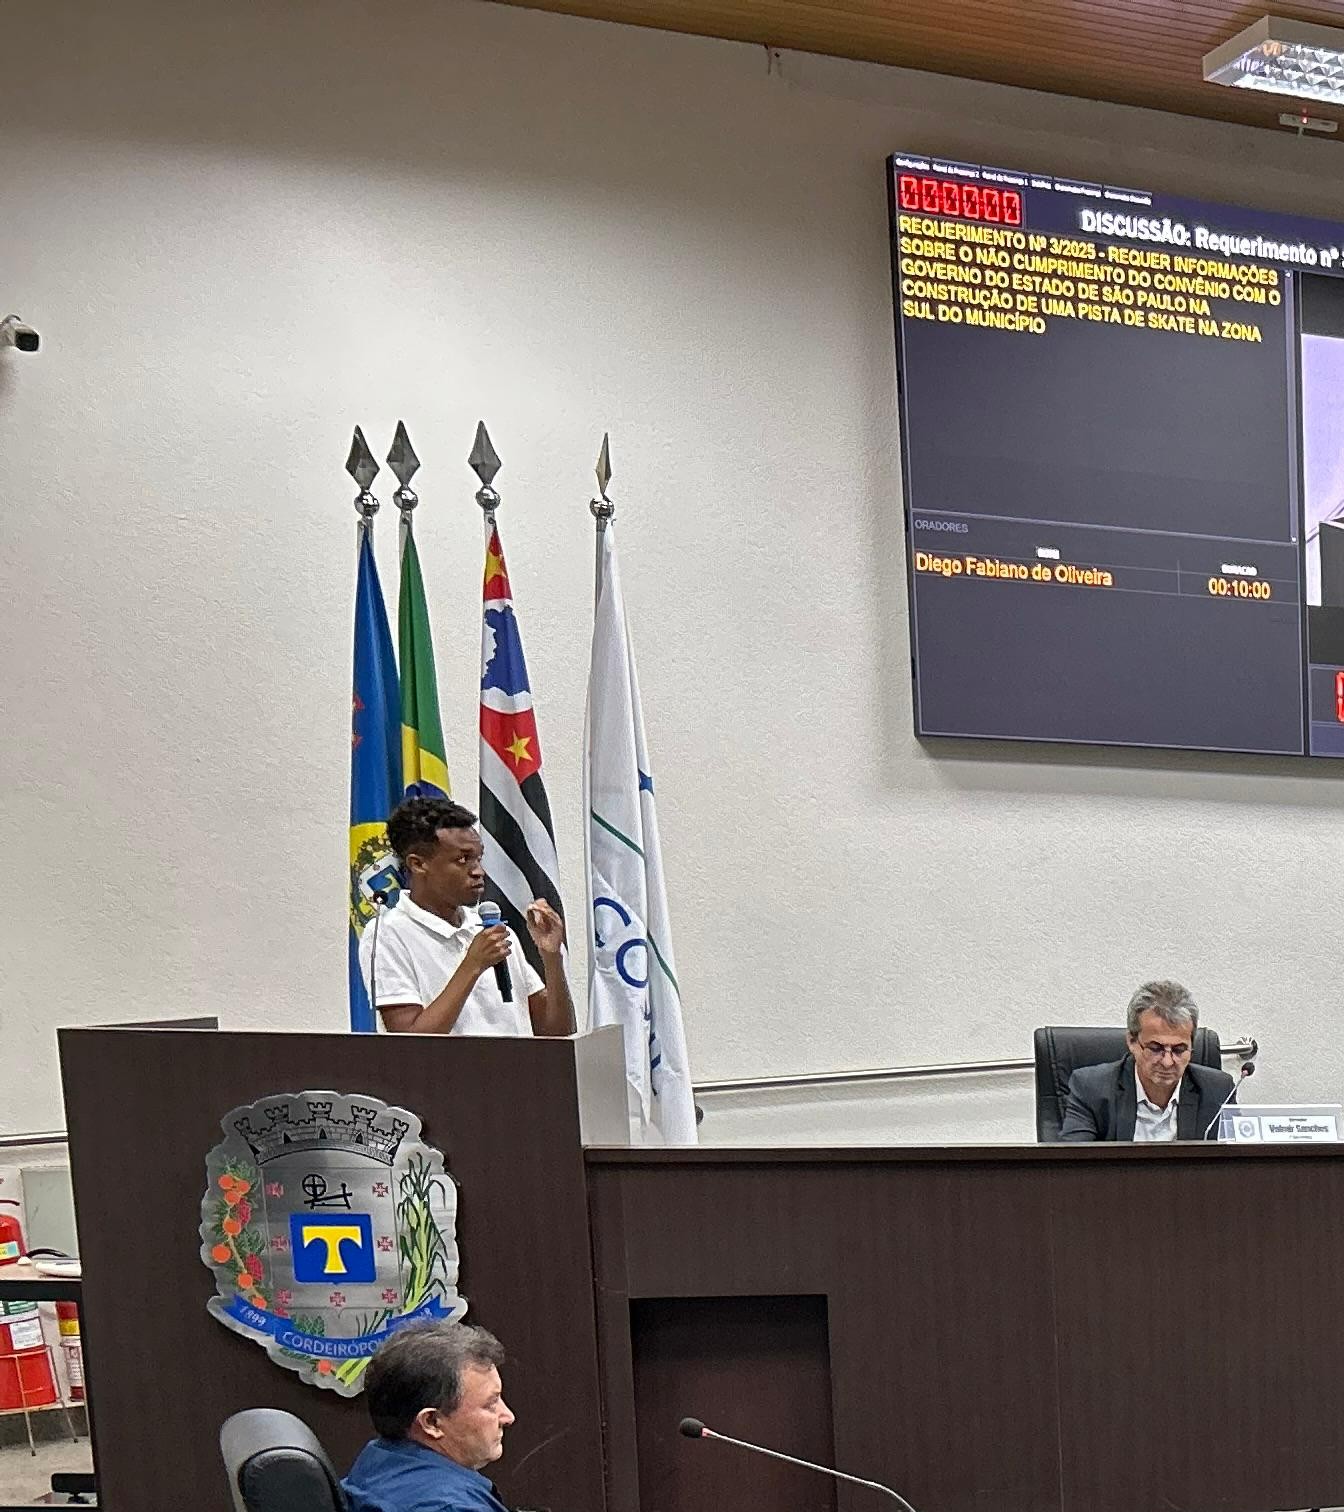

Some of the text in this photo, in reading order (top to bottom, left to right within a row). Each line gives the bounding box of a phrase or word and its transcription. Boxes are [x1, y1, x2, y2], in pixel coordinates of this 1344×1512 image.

[900, 216, 1025, 249] REQUERIMENTO
[1050, 238, 1095, 259] 3/2025
[1108, 246, 1170, 270] REQUER
[1174, 255, 1278, 285] INFORMAÇÕES
[1081, 209, 1191, 247] DISCUSSÃO:
[1195, 227, 1317, 266] Requerimento
[901, 238, 1280, 305] SOBRE O NÃO CUMPRIMENTO DO CONVÊNIO COM O
[902, 259, 1210, 315] GOVERNO DO ESTADO DE SÃO PAULO NA
[903, 281, 1262, 342] CONSTRUÇÃO DE UMA PISTA DE SKATE NA ZONA
[903, 302, 1046, 334] SUL DO MUNICÍPIO
[915, 520, 968, 533] ORADORES
[915, 552, 1113, 586] Diego Fabiano de Oliveira
[1208, 578, 1270, 599] 00:10:00
[282, 1332, 382, 1357] CORDEIRÓPO
